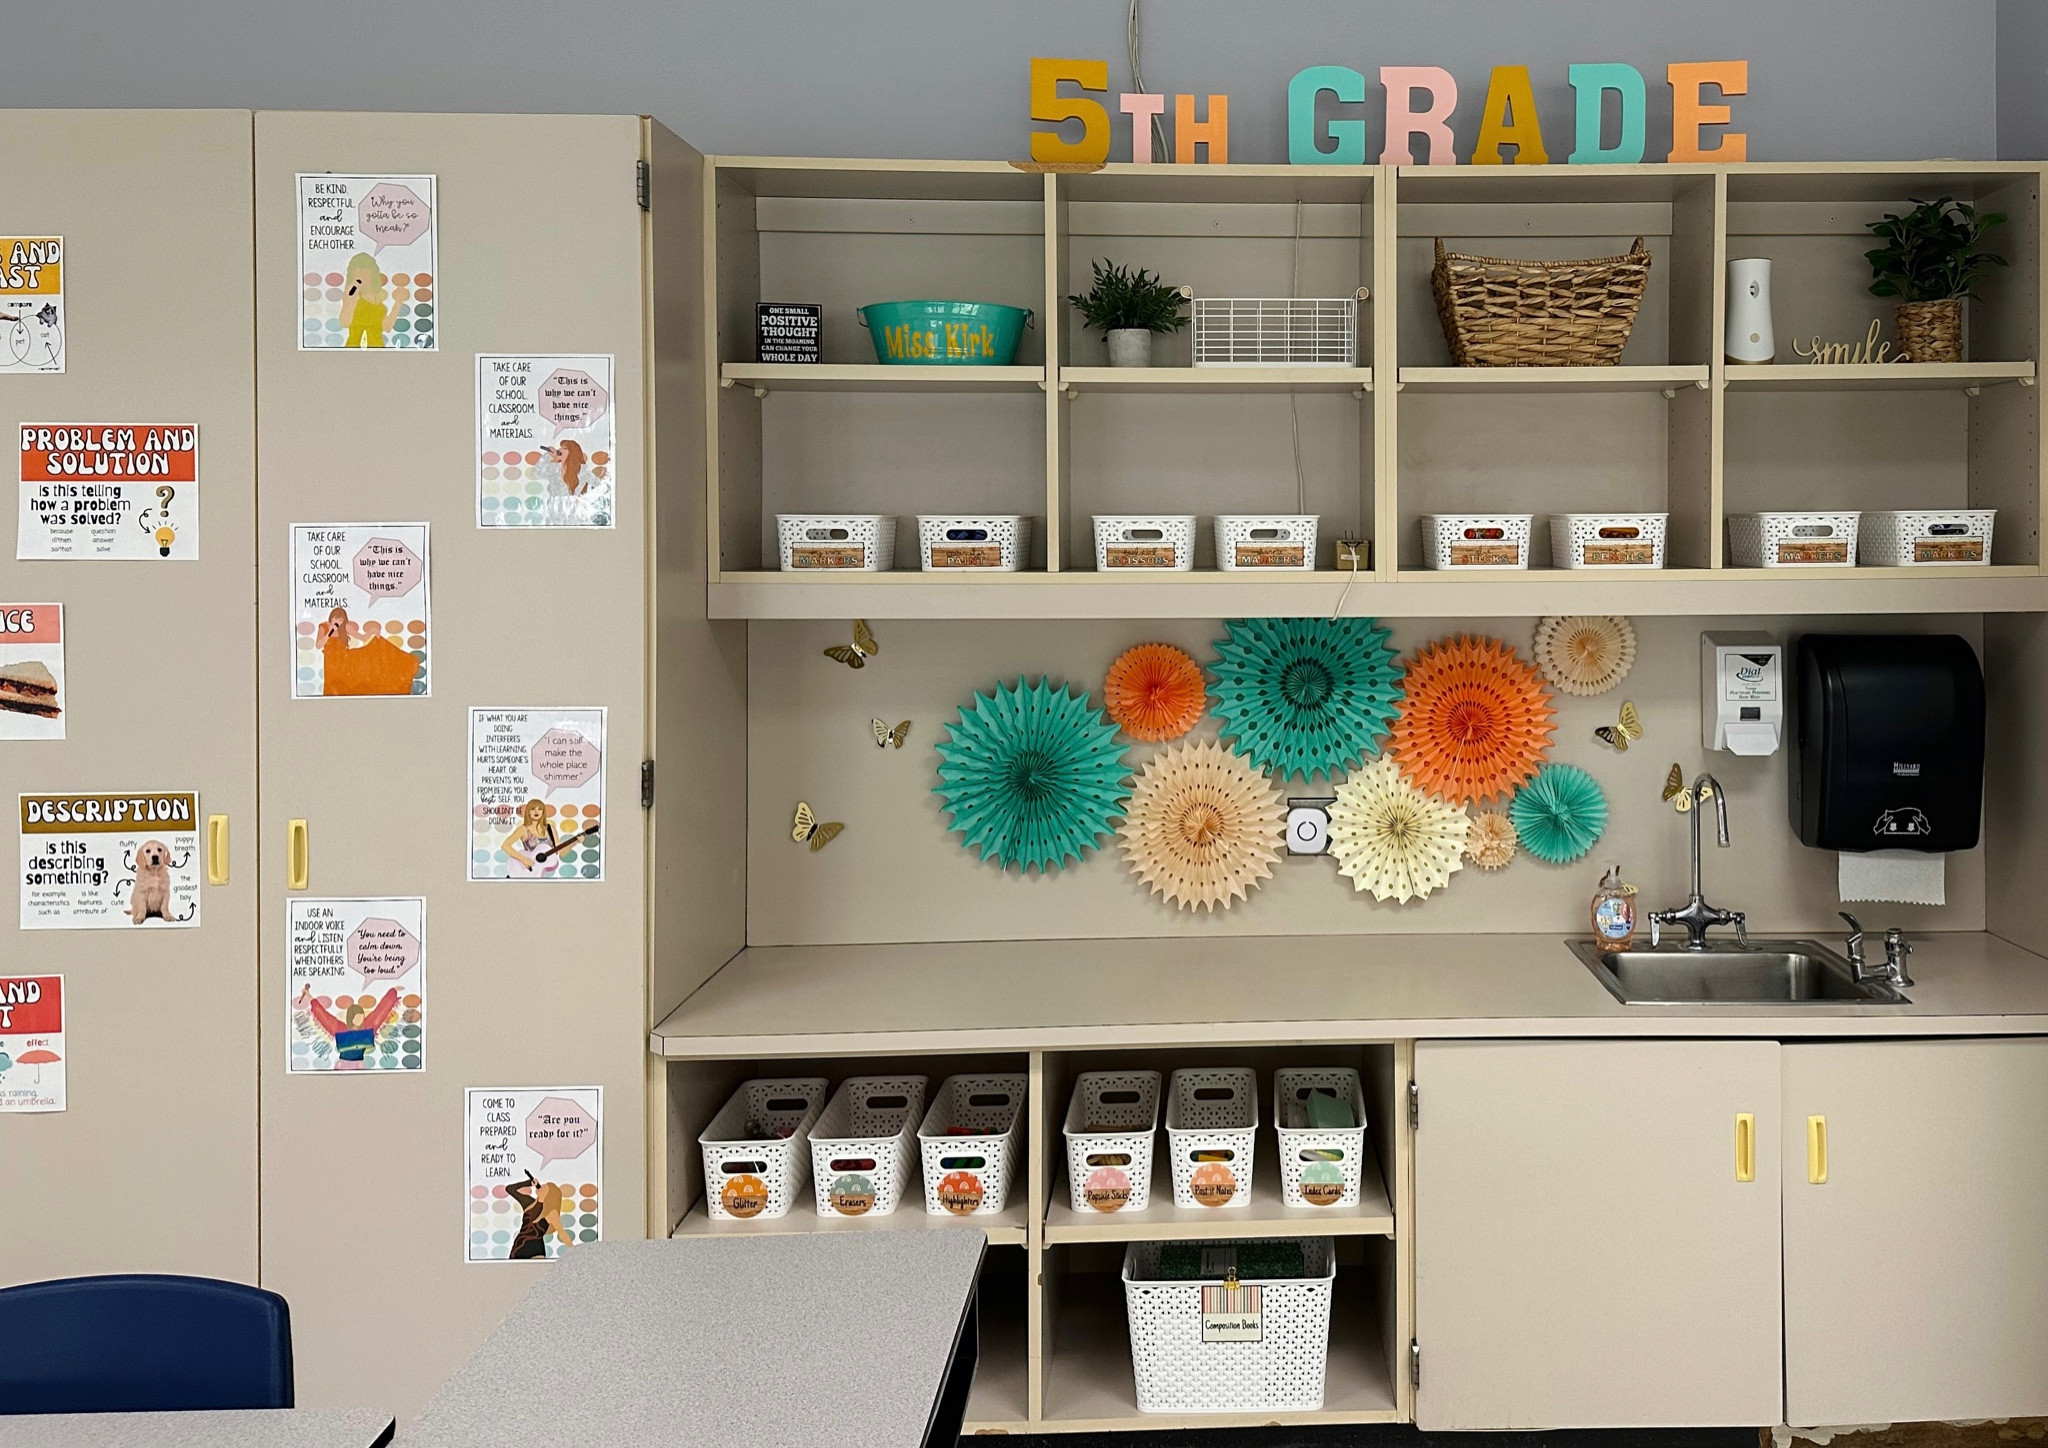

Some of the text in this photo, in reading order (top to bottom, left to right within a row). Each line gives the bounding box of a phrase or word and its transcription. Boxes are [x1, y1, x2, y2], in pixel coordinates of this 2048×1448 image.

[1030, 57, 1748, 166] 5TH GRADE
[315, 184, 324, 193] BE
[397, 200, 414, 209] you
[319, 209, 343, 222] and
[366, 211, 389, 222] gotta
[391, 209, 404, 219] be
[310, 226, 354, 236] ENCOURAGE
[308, 239, 331, 250] EACH
[9, 241, 60, 265] AND
[784, 307, 810, 315] SMALL
[761, 315, 818, 327] POSITIVE
[761, 326, 818, 337] THOUGHT
[884, 323, 995, 359] Miss Kirk
[1792, 319, 1910, 365] smile
[762, 353, 818, 362] WHOLE DAY
[492, 362, 531, 372] TAKE CARE
[499, 376, 526, 386] OF OUR
[580, 377, 588, 385] is
[545, 389, 562, 398] why
[552, 401, 589, 409] have nice
[501, 415, 519, 426] and
[21, 427, 195, 452] PROBLEM AND
[46, 451, 170, 475] SOLUTION
[53, 484, 78, 497] this
[81, 484, 121, 499] telling
[31, 498, 131, 513] how a problem
[40, 512, 122, 525] was solved?
[307, 532, 346, 542] TAKE CARE
[313, 545, 341, 556] OF OUR
[395, 546, 403, 554] is
[1921, 549, 1977, 559] MARKERS
[799, 555, 858, 565] MARKERS
[947, 556, 986, 565] PAINT
[1112, 555, 1169, 565] SCISSORS
[1241, 555, 1298, 565] MARKERS
[1461, 554, 1508, 564] STICKS
[1592, 551, 1645, 561] PENCILS
[1784, 551, 1841, 561] MARKERS
[359, 558, 376, 568] why
[367, 570, 404, 579] have nice
[315, 584, 334, 596] and
[478, 713, 528, 722] IF WHAT YOU ARE
[494, 724, 513, 733] DOING
[486, 734, 521, 743] INTERFERES
[478, 745, 496, 753] WITH
[545, 749, 583, 757] make the
[477, 755, 496, 764] HURTS
[508, 766, 517, 774] OR
[539, 760, 588, 770] whole place
[481, 776, 524, 784] PREVENTS YOU
[477, 786, 529, 794] FROM BEING YOUR
[513, 795, 525, 803] YOU
[26, 797, 190, 823] DESCRIPTION
[516, 807, 523, 815] BE
[488, 817, 508, 825] DOING
[61, 840, 87, 854] this
[28, 856, 105, 871] describing
[25, 870, 109, 886] something?
[307, 908, 333, 918] USE AN
[295, 920, 345, 930] INDOOR VOICE
[294, 930, 343, 943] and LISTEN
[377, 929, 406, 938] need to
[294, 944, 343, 954] RESPECTFULLY
[358, 941, 378, 950] calm
[294, 955, 344, 965] WHEN OTHERS
[384, 953, 405, 966] being
[293, 966, 307, 976] ARE
[363, 966, 376, 974] too
[26, 1039, 49, 1047] effect
[482, 1098, 515, 1109] COME TO
[487, 1112, 511, 1123] CLASS
[563, 1117, 580, 1126] you
[480, 1125, 517, 1136] PREPARED
[529, 1128, 571, 1140] ready for
[485, 1137, 509, 1151] and
[481, 1153, 516, 1164] READY TO
[1304, 1184, 1341, 1196] Index Cards
[733, 1197, 758, 1209] Glitter
[839, 1195, 866, 1207] Erasers
[942, 1194, 979, 1210] Highlighters
[1205, 1319, 1259, 1332] Composition Books
